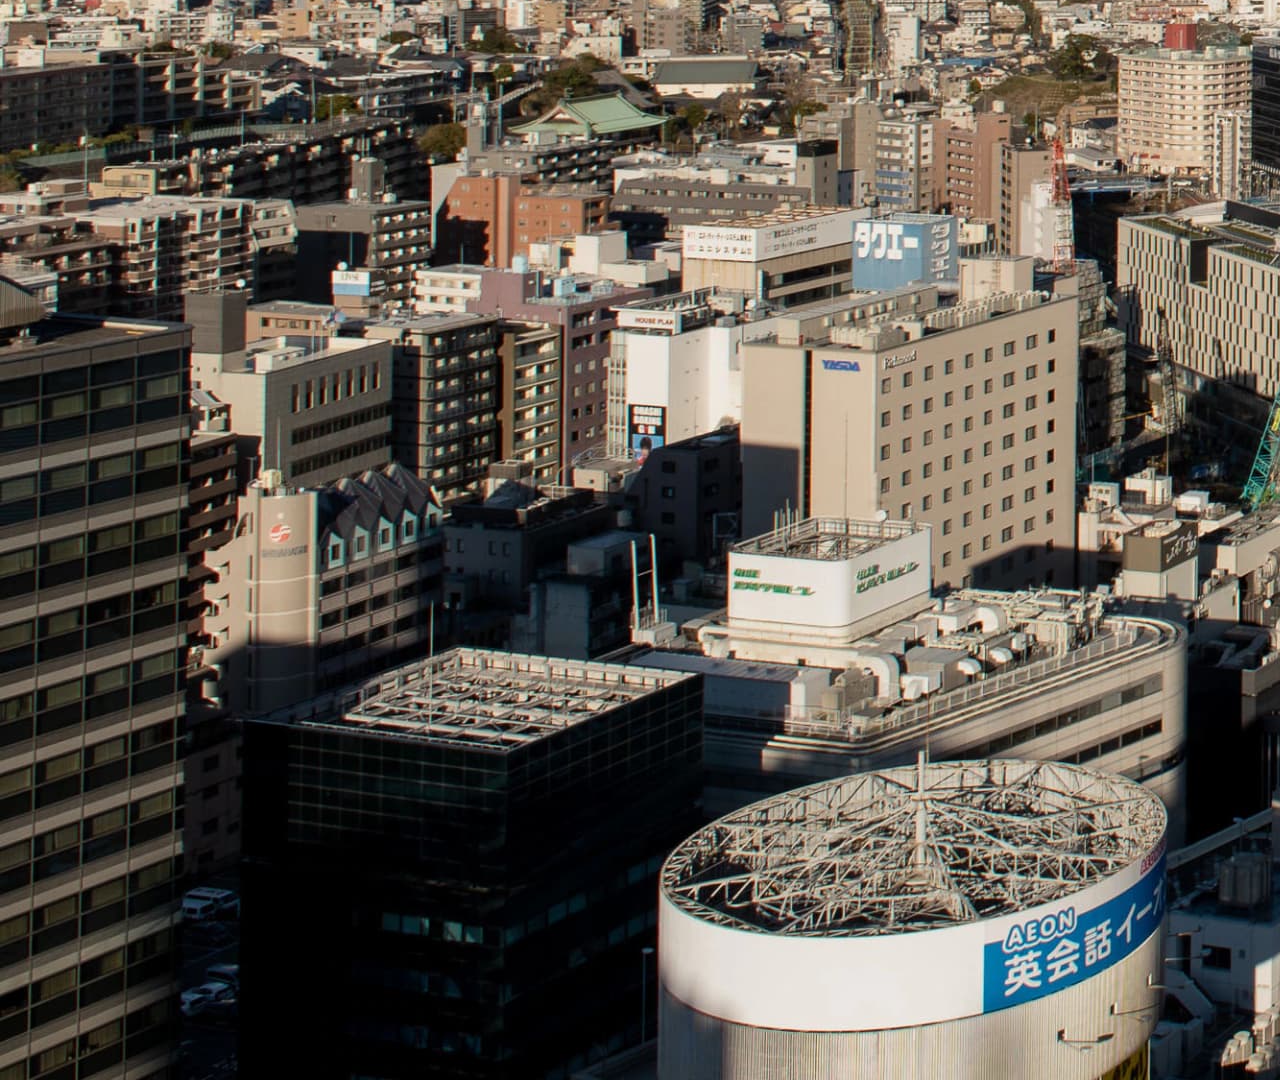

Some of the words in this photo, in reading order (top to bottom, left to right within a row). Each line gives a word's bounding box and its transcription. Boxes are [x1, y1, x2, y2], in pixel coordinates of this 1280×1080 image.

[854, 222, 919, 260] タクエー
[930, 222, 951, 280] タクエー
[1004, 907, 1076, 950] AEON
[1004, 878, 1165, 997] 英会話イーオ
